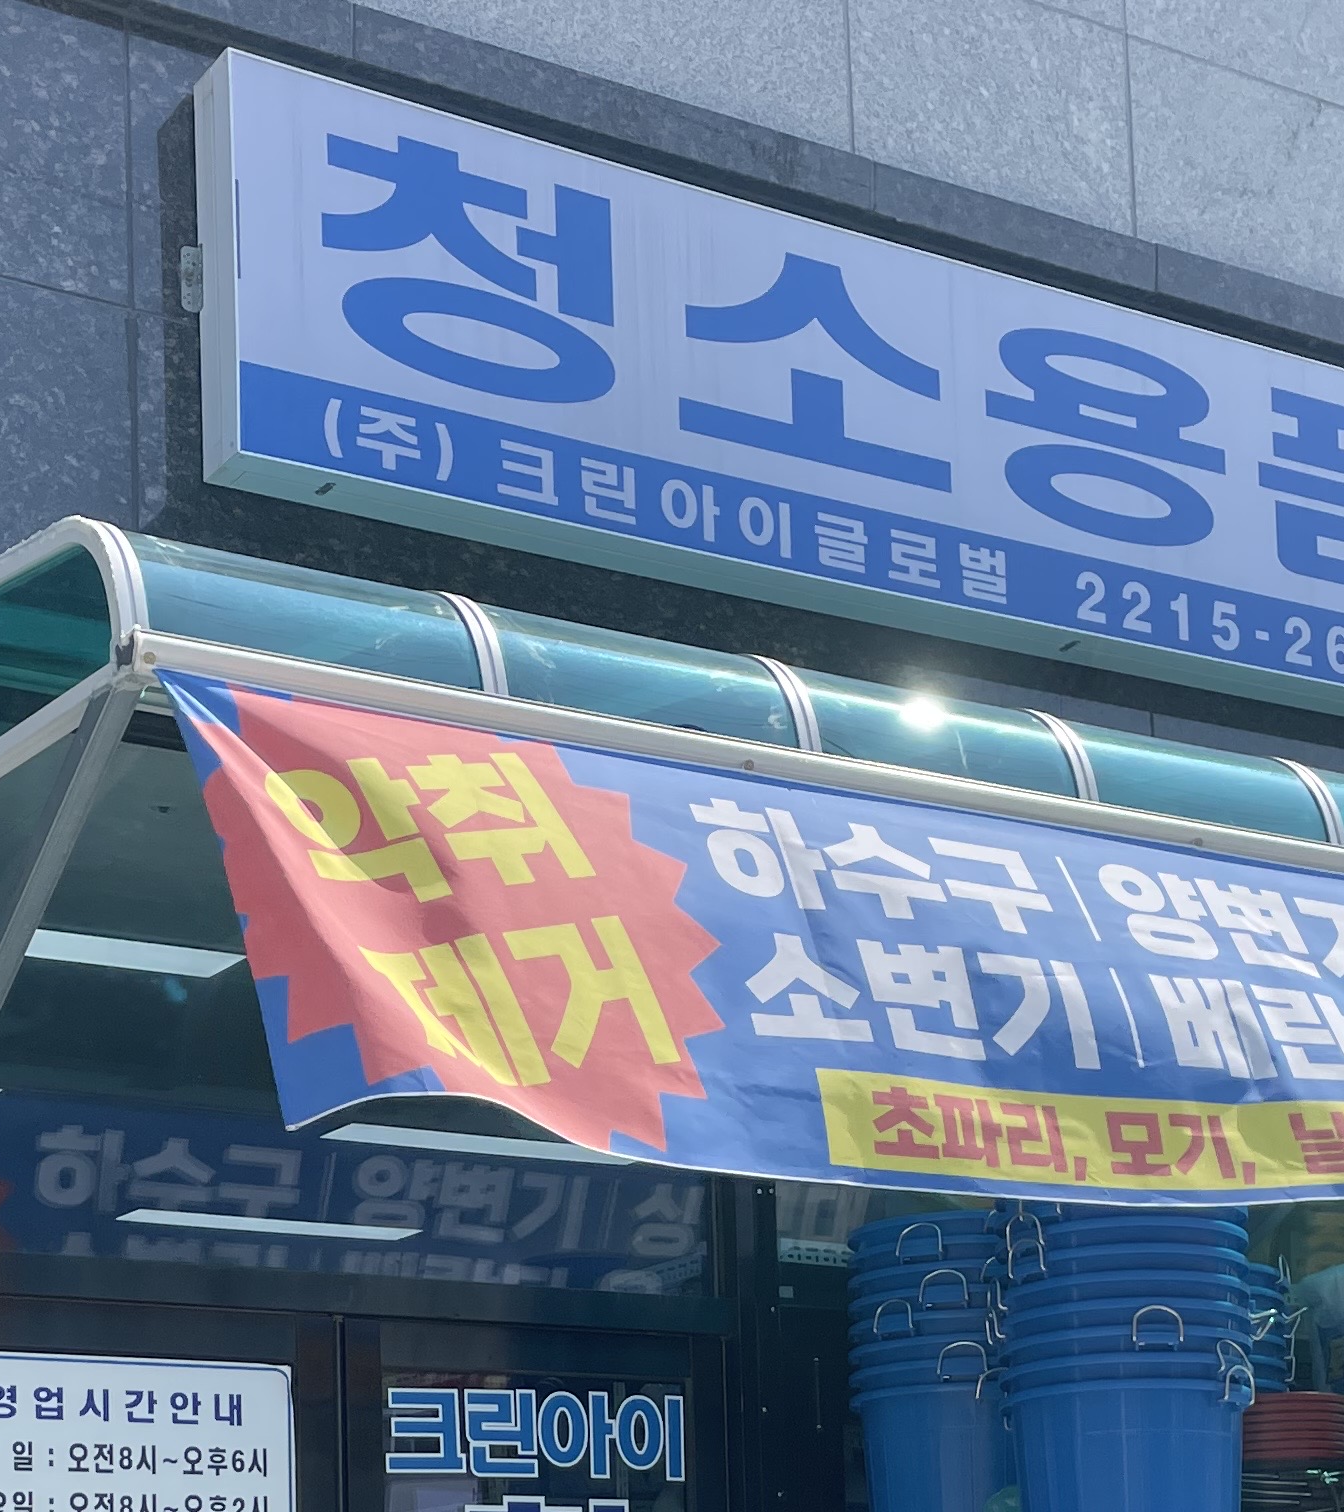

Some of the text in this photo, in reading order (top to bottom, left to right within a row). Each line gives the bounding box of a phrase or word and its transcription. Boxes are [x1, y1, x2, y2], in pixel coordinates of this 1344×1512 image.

[323, 398, 456, 481] (주)
[497, 439, 1009, 605] 크린아이글로벌
[265, 753, 595, 903] 악취
[689, 798, 1052, 934] 하수구
[357, 915, 680, 1086] 제거
[745, 933, 1101, 1070] 소변기
[872, 1086, 1086, 1182] 초파리,
[1105, 1111, 1256, 1185] 모기,
[68, 1443, 269, 1477] 오전8시~오후6시
[385, 1386, 687, 1482] 크린아이
